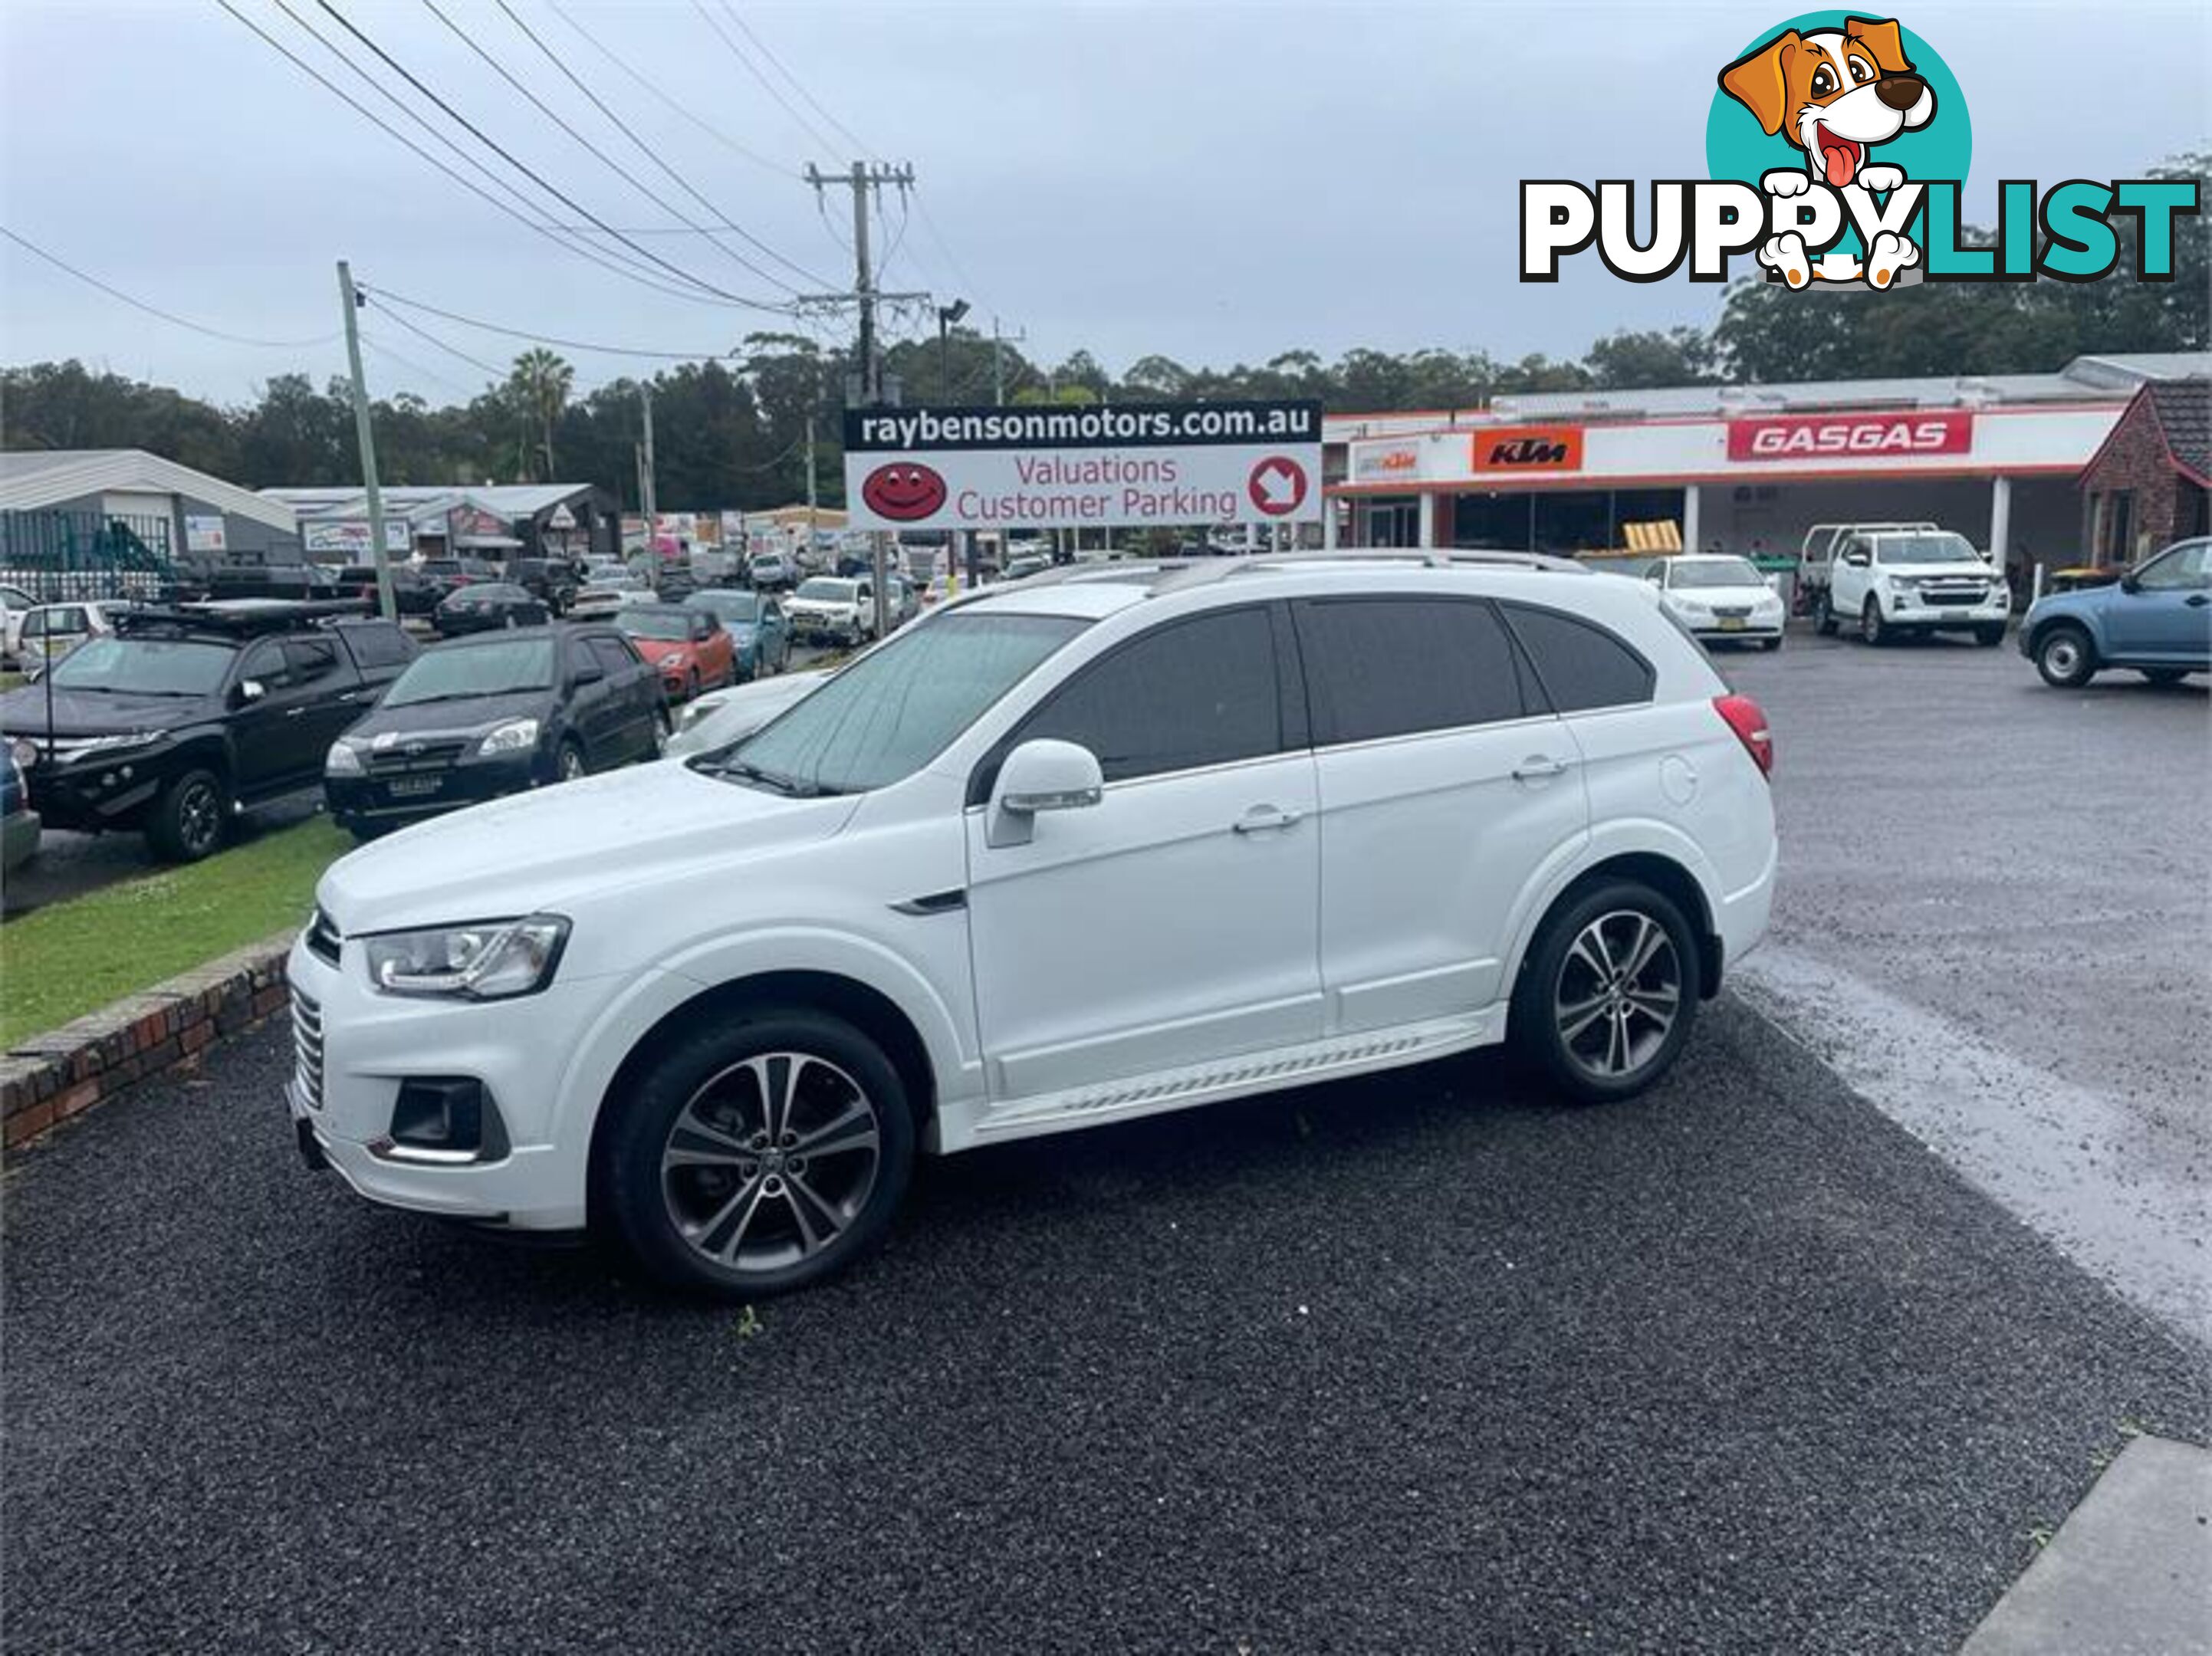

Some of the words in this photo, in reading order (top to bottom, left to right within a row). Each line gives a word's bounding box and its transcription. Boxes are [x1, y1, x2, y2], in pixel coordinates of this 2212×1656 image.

[862, 408, 1310, 447] raybensonmotors.com.au
[1752, 422, 1947, 452] GASGAS
[1488, 438, 1567, 465] KTM
[1016, 454, 1175, 486] Valuations
[957, 491, 1110, 521] Customer
[1123, 488, 1237, 521] Parking
